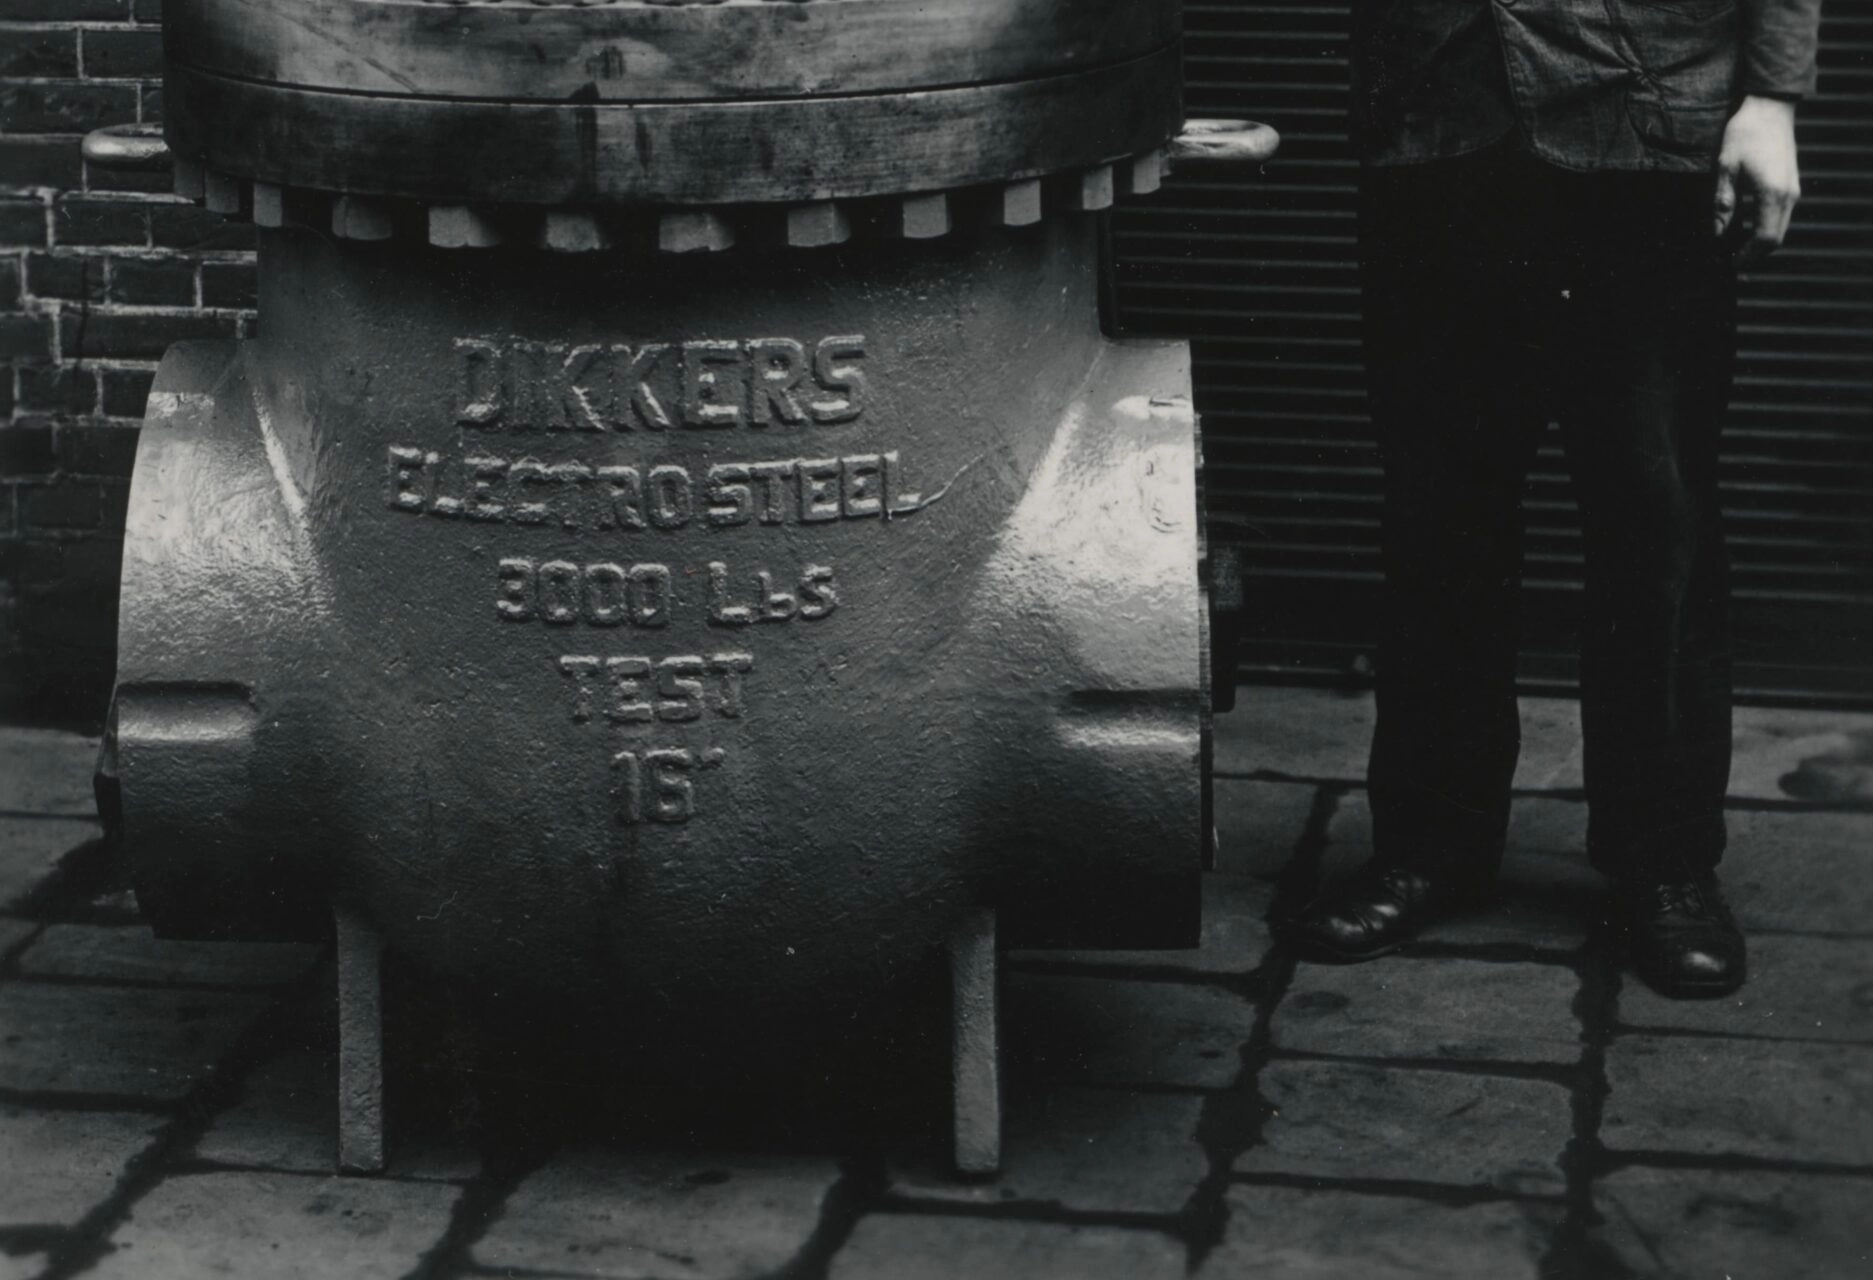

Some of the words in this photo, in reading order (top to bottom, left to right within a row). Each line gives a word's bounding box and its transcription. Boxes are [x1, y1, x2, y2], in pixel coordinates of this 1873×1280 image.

[453, 333, 867, 431] DIKKERS
[496, 557, 671, 626] 3000
[559, 651, 754, 723] TEST
